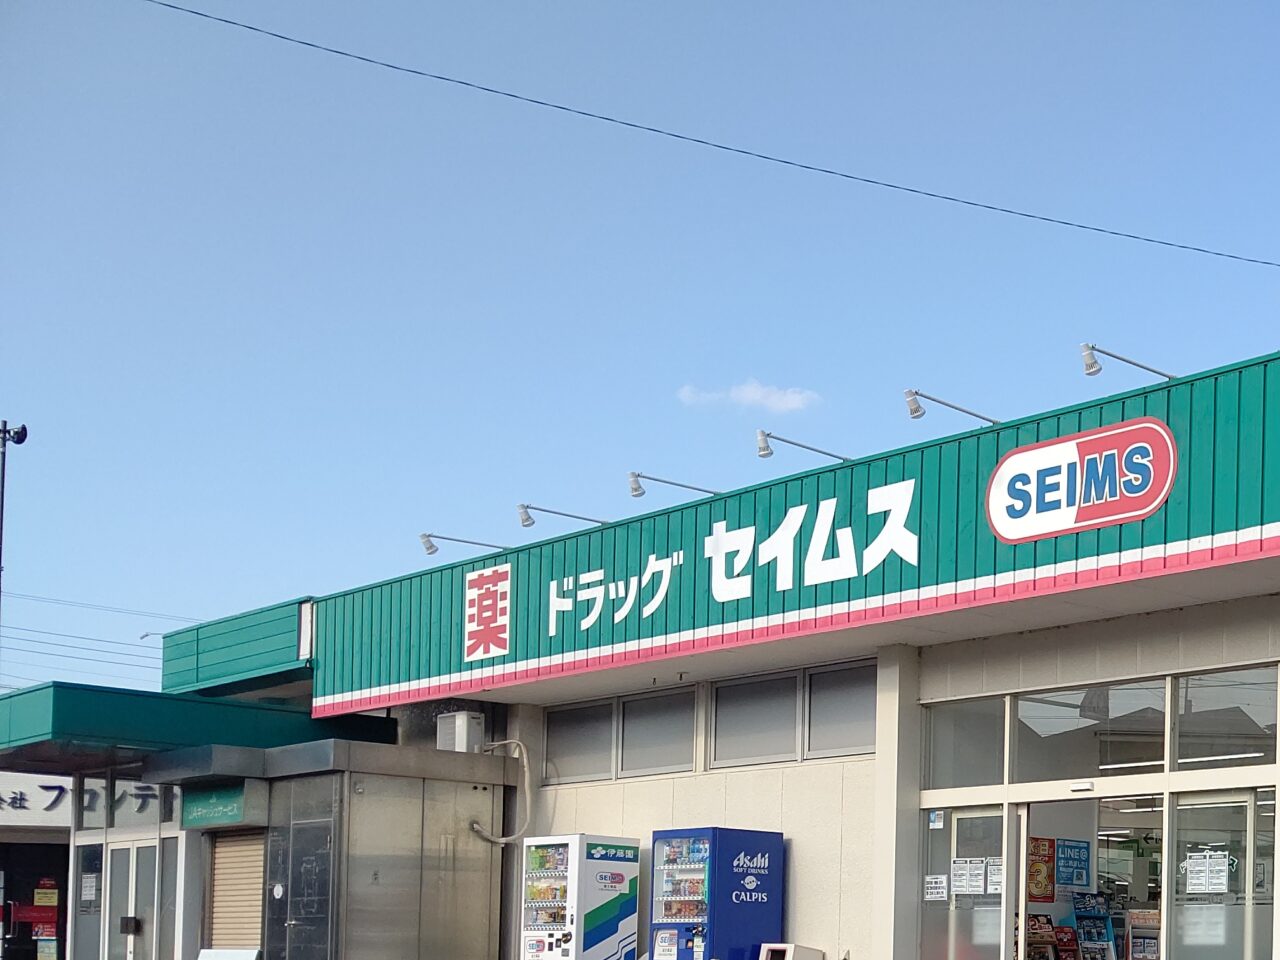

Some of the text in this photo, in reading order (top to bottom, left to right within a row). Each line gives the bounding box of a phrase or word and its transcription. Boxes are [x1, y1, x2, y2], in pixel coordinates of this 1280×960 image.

[1005, 442, 1155, 520] SEIMS
[548, 478, 918, 637] ドラッグ セイムス
[466, 568, 509, 659] 薬
[0, 784, 178, 814] 社 フロンテ
[607, 848, 634, 859] 伊藤園
[733, 851, 769, 868] Asahi
[1058, 847, 1088, 860] LINE@
[732, 890, 768, 904] CALPIS
